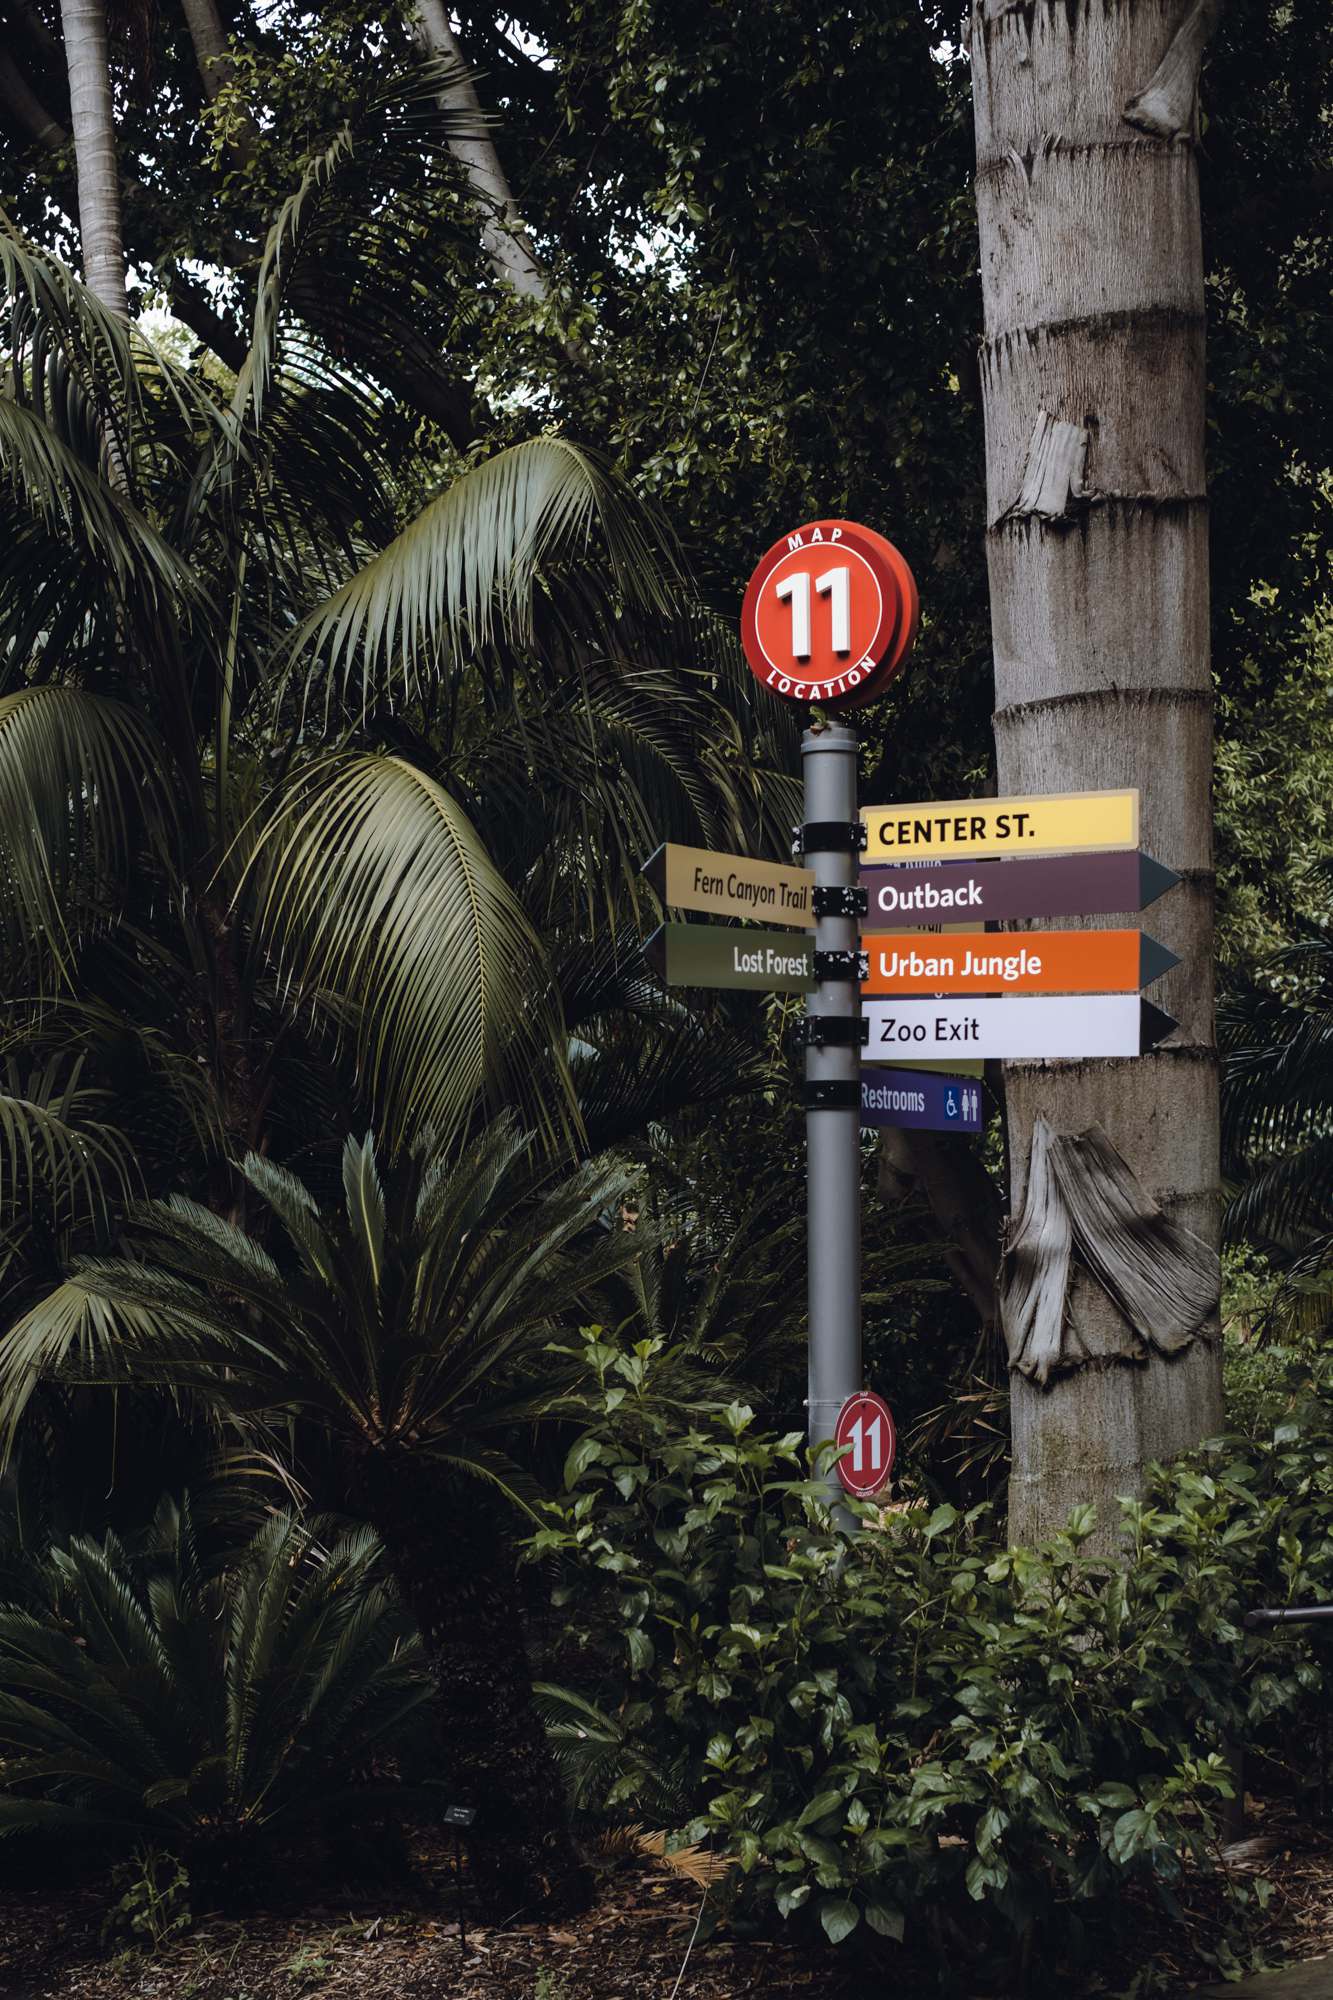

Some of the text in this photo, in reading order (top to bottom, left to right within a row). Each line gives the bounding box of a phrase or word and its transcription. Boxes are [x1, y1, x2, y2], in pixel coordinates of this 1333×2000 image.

[787, 527, 843, 551] MAP
[775, 566, 851, 657] 11
[766, 655, 877, 700] LOCATION
[879, 813, 1036, 846] CENTER ST.
[693, 867, 808, 911] Fern Canyon Trail
[877, 879, 984, 912] Outback
[733, 946, 809, 977] Lost Forest
[879, 949, 1043, 981] Urban Jungle
[880, 1016, 981, 1042] Zoo Exit
[861, 1082, 926, 1113] Restrooms
[846, 1414, 881, 1472] 11
